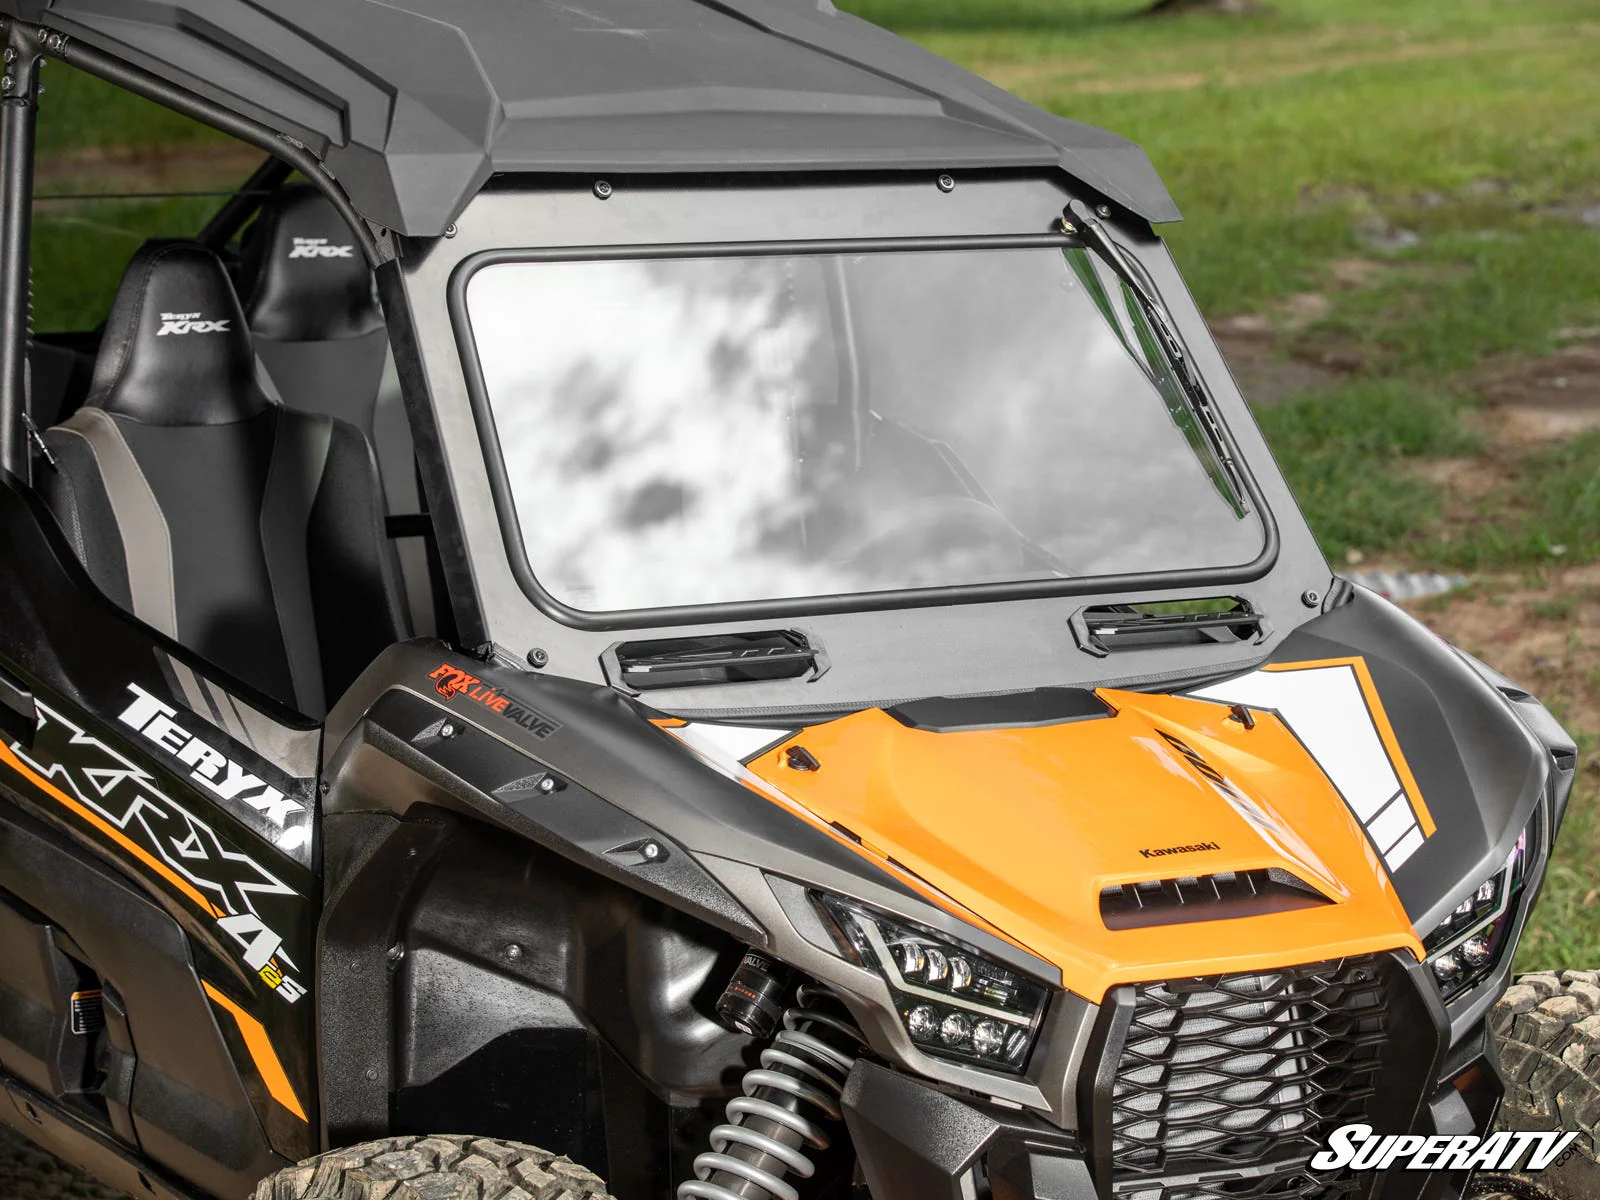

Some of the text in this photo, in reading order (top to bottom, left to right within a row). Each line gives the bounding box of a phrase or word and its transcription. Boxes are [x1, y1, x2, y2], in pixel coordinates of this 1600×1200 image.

[288, 245, 354, 259] KRX
[156, 320, 231, 336] KRX
[428, 663, 481, 696] FOX
[117, 681, 305, 828] TERYX
[1139, 841, 1221, 858] Kawasaki
